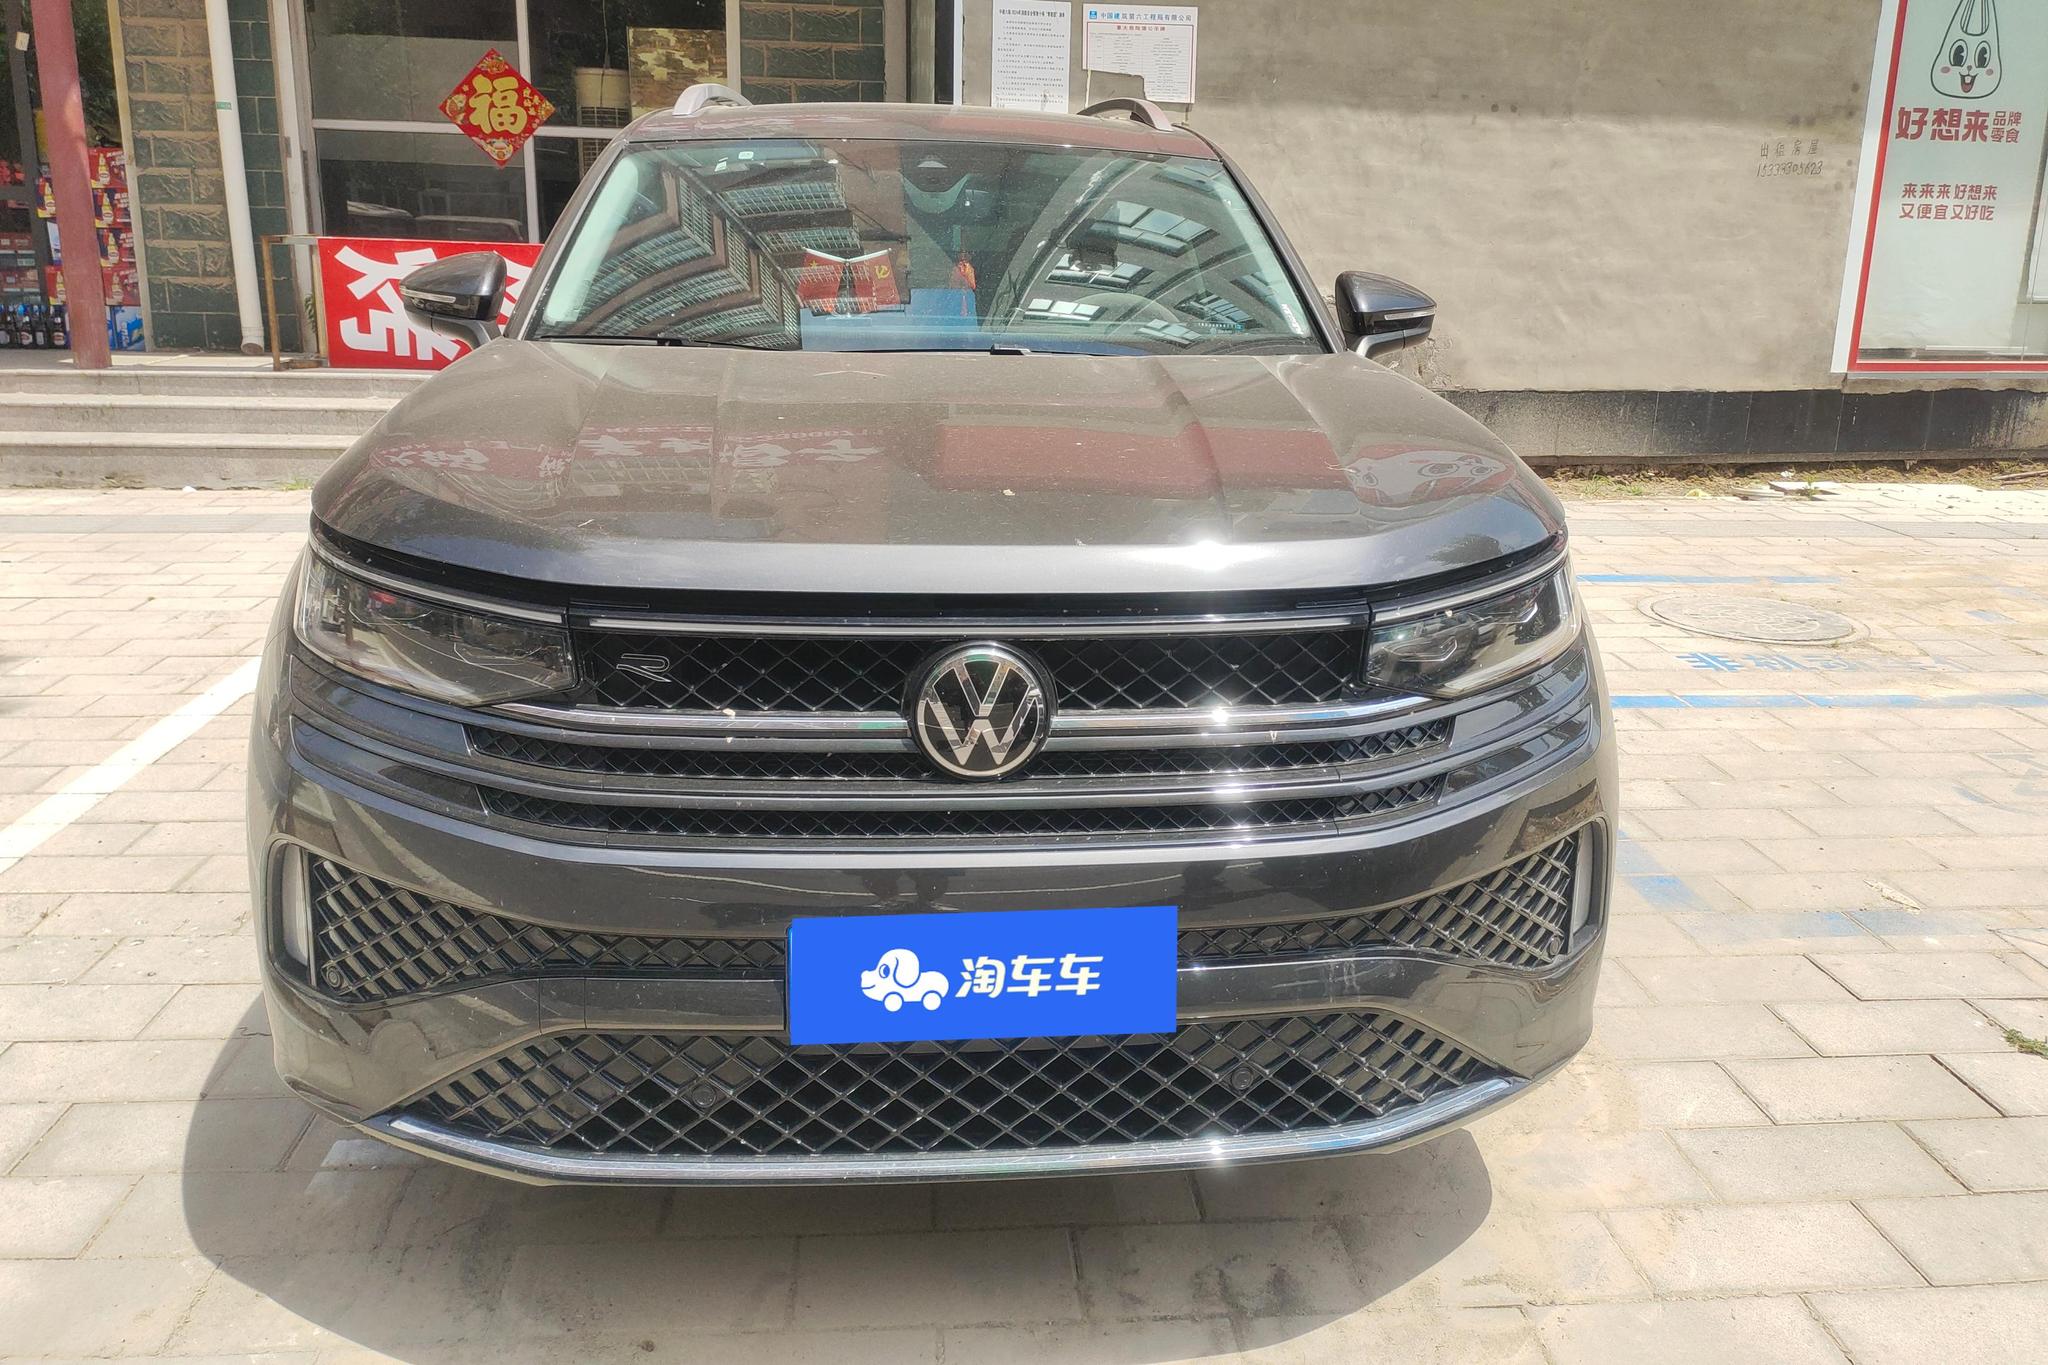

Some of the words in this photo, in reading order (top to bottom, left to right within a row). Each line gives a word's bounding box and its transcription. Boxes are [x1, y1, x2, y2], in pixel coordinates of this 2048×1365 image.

[468, 74, 527, 134] 福
[1895, 106, 1990, 142] 好想来
[1991, 110, 2022, 127] 品牌
[1990, 127, 2020, 143] 零食
[1899, 203, 1996, 220] 又便宜又好吃
